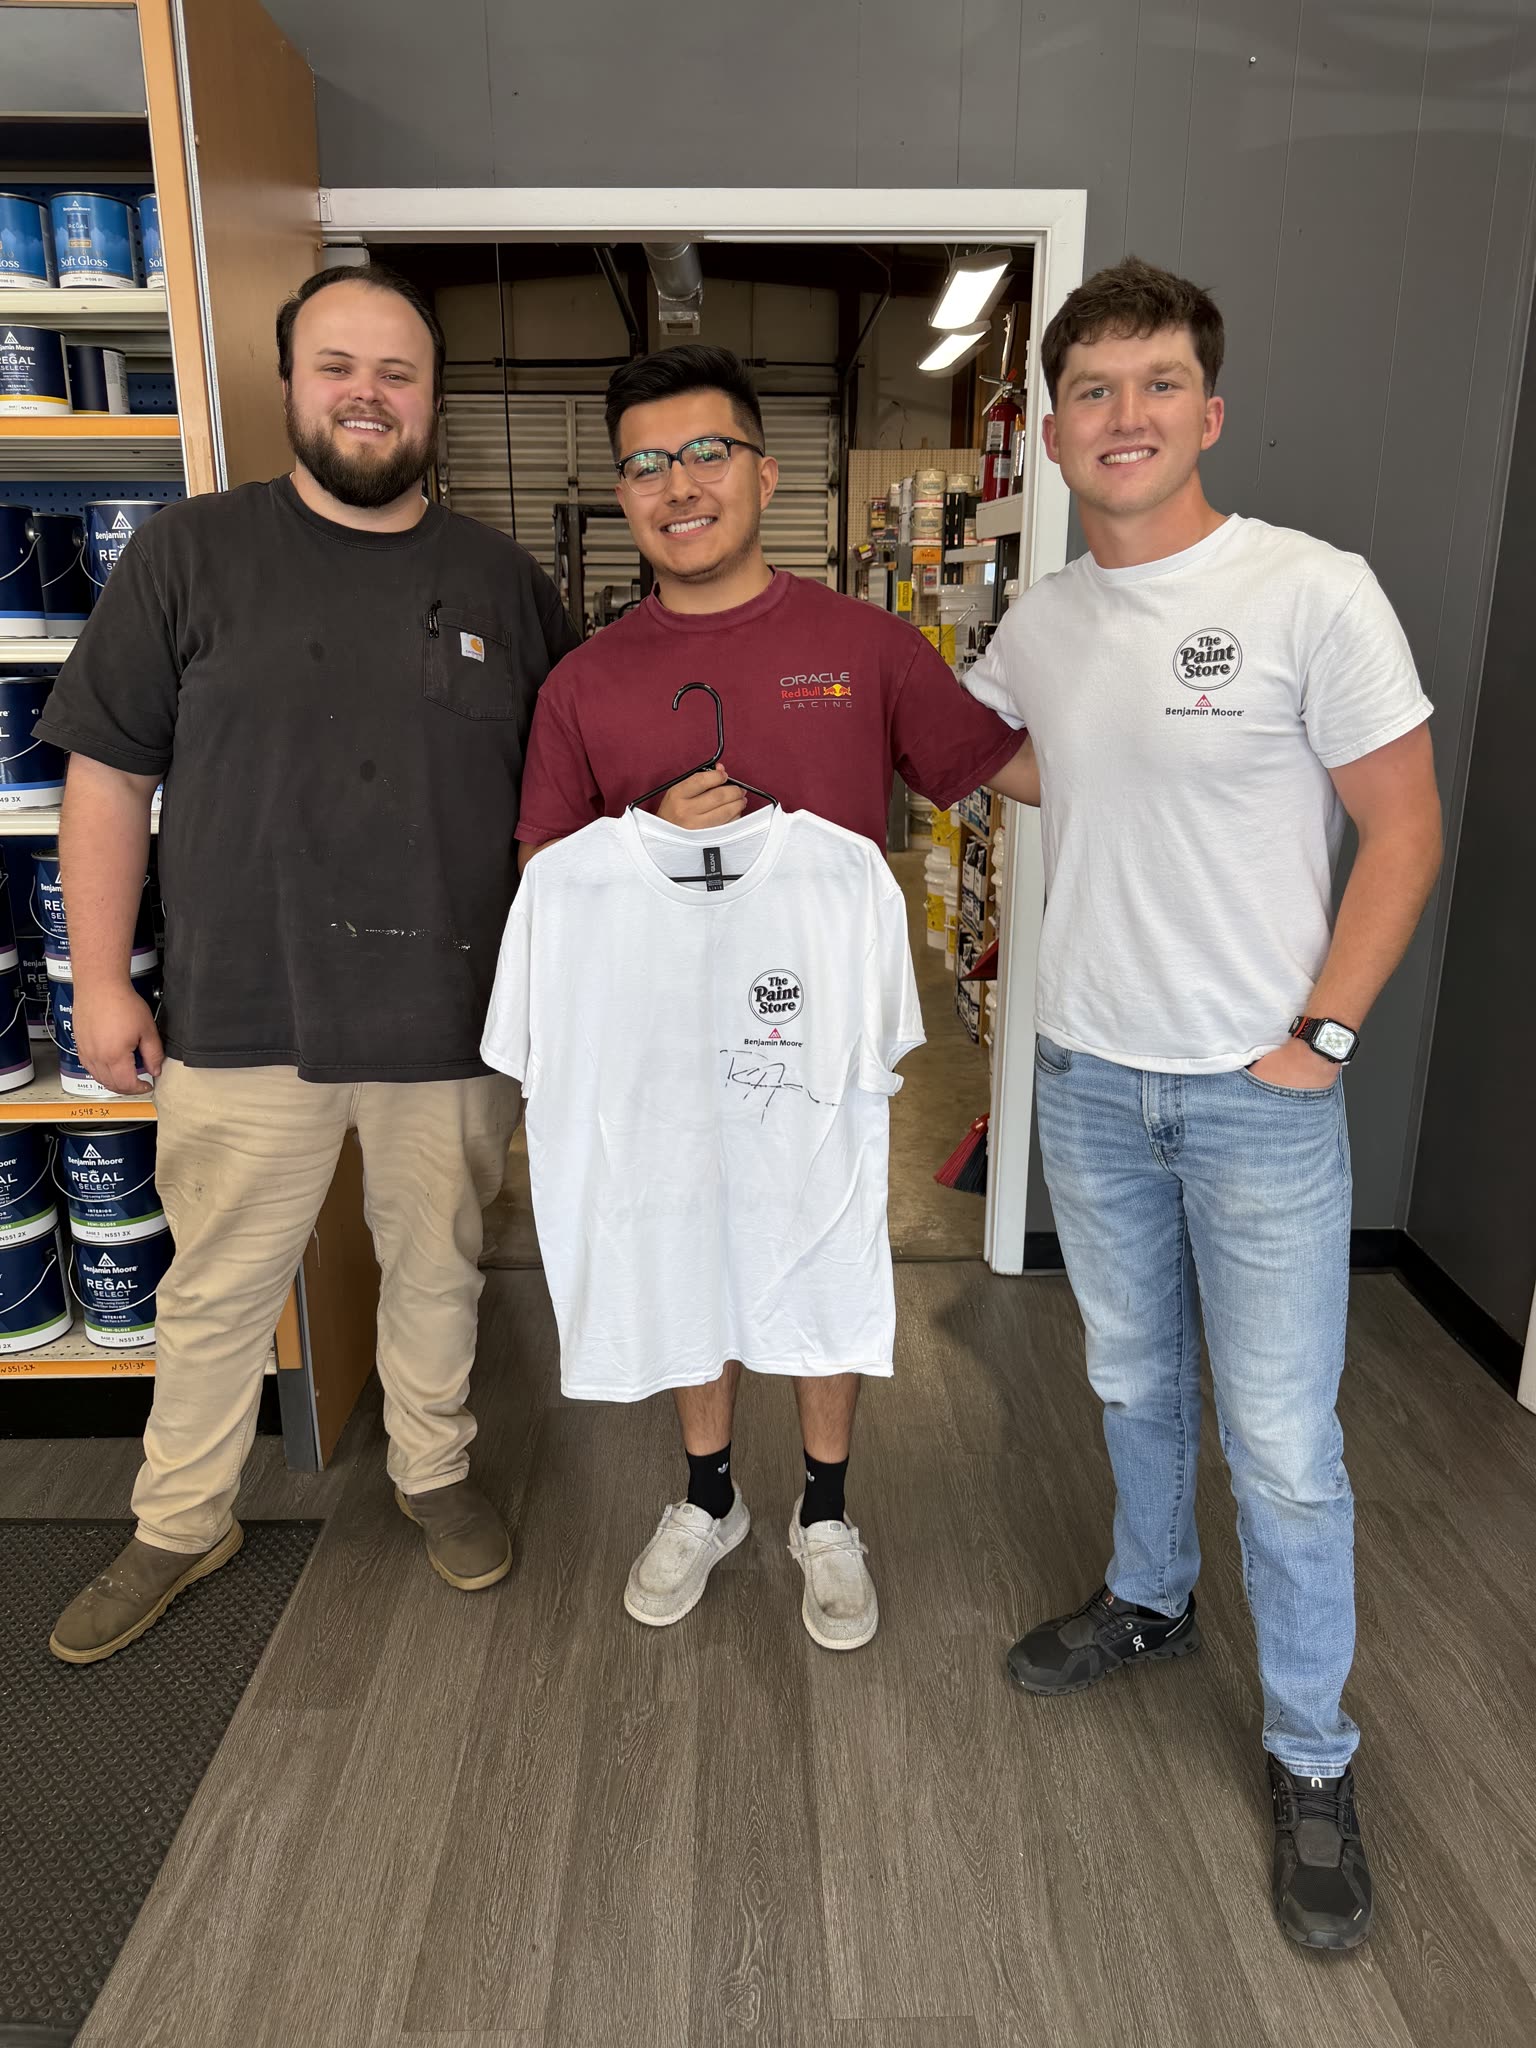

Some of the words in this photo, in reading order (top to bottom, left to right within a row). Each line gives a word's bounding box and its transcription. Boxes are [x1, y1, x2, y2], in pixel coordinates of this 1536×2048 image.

[61, 256, 76, 267] Soft
[78, 256, 108, 267] Gloss
[0, 356, 36, 365] EGAL
[96, 531, 126, 541] Benjamin
[1198, 636, 1221, 647] The
[1180, 644, 1235, 666] Paint
[1184, 663, 1230, 679] Store
[780, 672, 850, 686] ORACLE
[781, 687, 800, 698] Red
[801, 686, 820, 696] Bull
[783, 701, 852, 710] RACING
[1165, 707, 1208, 717] Benjamin
[1211, 708, 1243, 716] Moore
[768, 976, 788, 986] The
[754, 985, 800, 1002] Paint
[759, 1001, 796, 1014] Store
[744, 1038, 778, 1046] Benjamin
[68, 1156, 96, 1166] Benjamin
[98, 1158, 123, 1166] Moore
[71, 1171, 124, 1183] REGAL
[83, 1264, 111, 1274] Benjamin
[112, 1266, 137, 1274] Moore
[86, 1278, 138, 1290] REGAL
